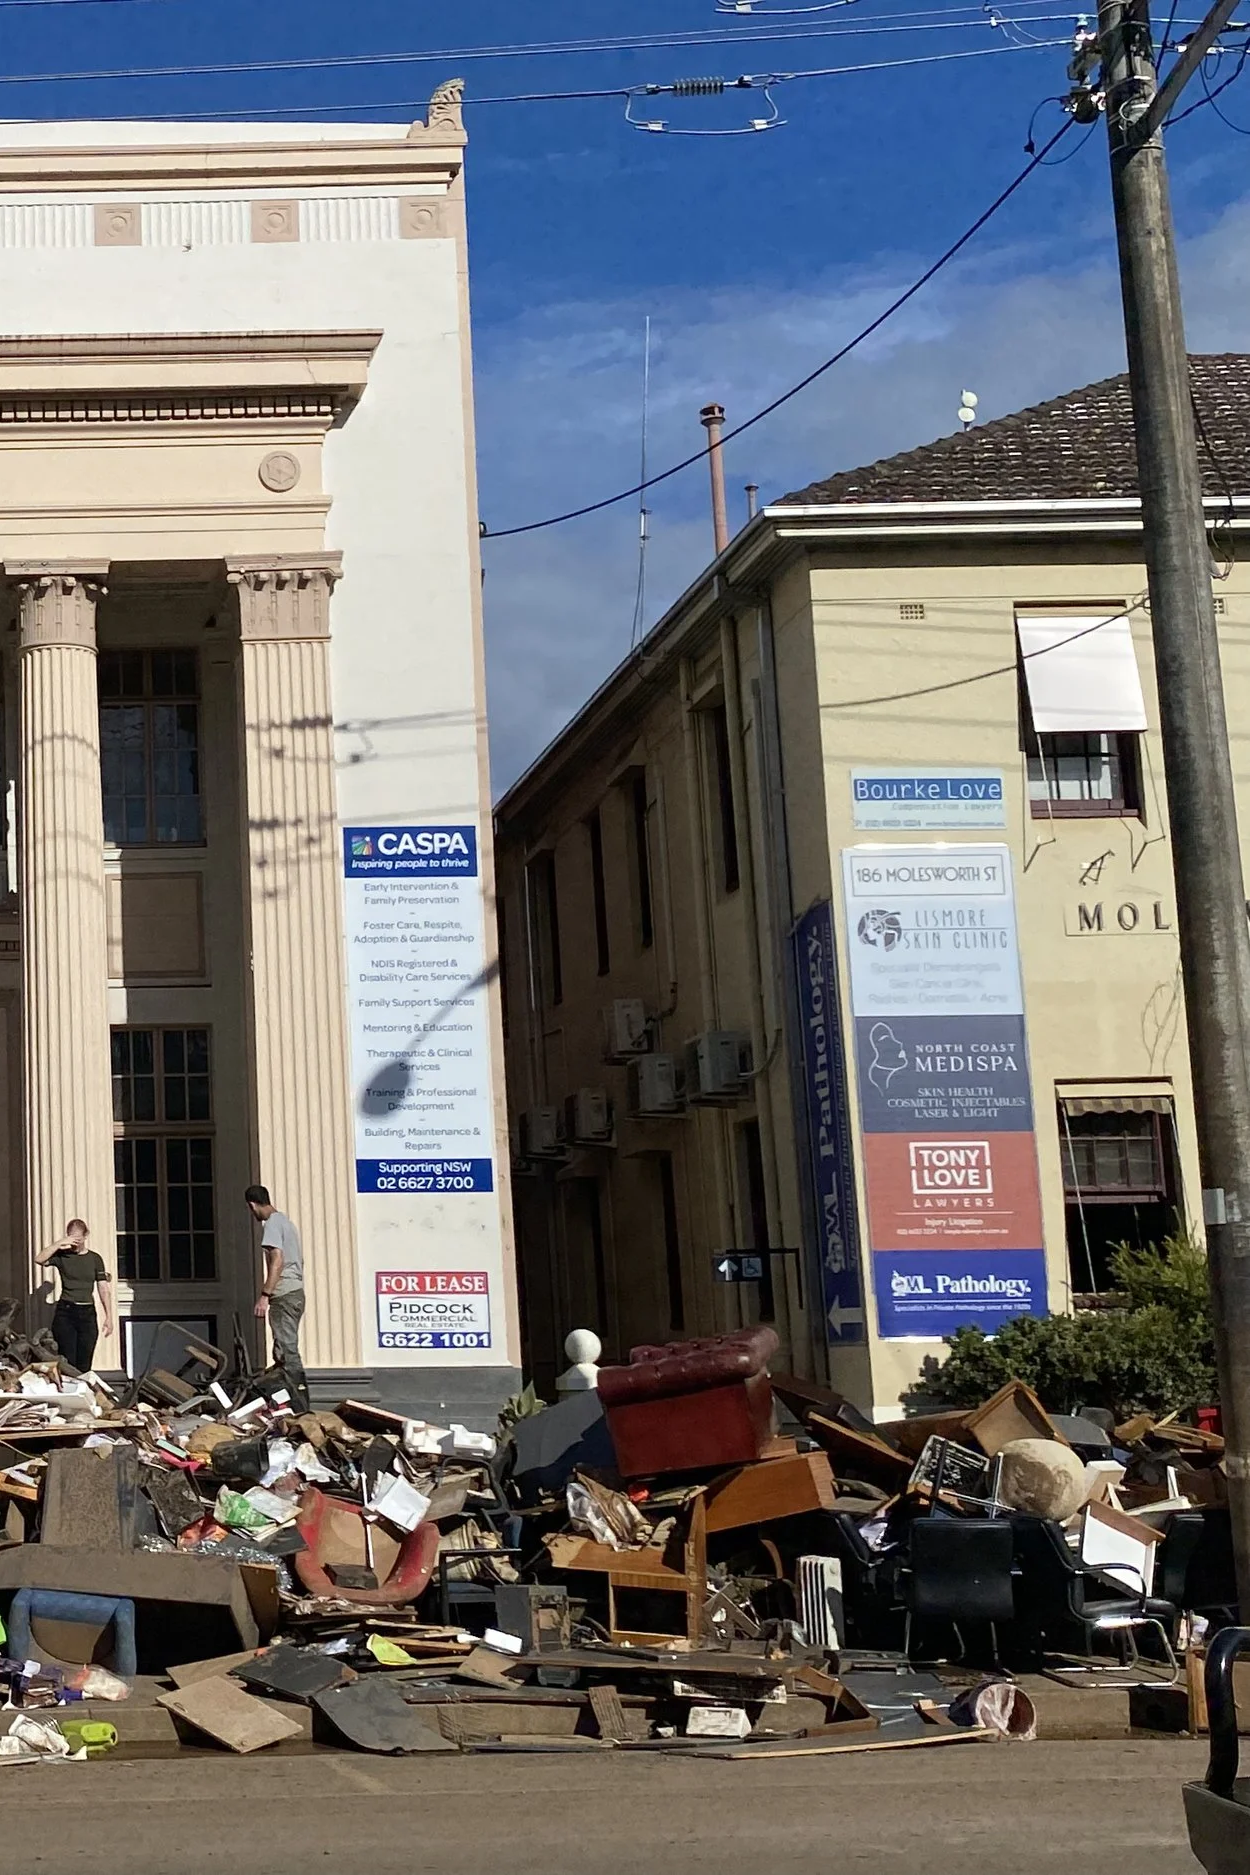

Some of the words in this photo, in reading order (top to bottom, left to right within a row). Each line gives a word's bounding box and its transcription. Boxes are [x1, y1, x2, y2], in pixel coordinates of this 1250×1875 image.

[377, 832, 468, 855] CASPA
[352, 859, 392, 870] Inspiring
[395, 860, 427, 870] people
[429, 860, 440, 868] to
[441, 859, 469, 868] thrive
[856, 869, 882, 883] 186
[886, 867, 980, 882] MOLESWORTH
[984, 866, 997, 881] ST
[364, 883, 388, 893] Early
[390, 883, 449, 891] Intervention
[451, 882, 459, 890] &
[364, 897, 396, 906] Family
[398, 896, 459, 905] Preservation
[915, 909, 986, 927] LISMORE
[1078, 901, 1172, 931] MOL
[363, 921, 394, 930] Foster
[354, 935, 398, 945] Adoption
[400, 935, 408, 943] &
[409, 934, 475, 944] Guardianship
[903, 932, 941, 949] SKIN
[953, 931, 1008, 948] CLINIC
[371, 960, 395, 968] NDIS
[397, 959, 449, 969] Registered
[450, 959, 458, 967] &
[360, 973, 403, 983] Disability
[405, 973, 429, 982] Care
[430, 973, 471, 982] Services
[359, 999, 391, 1008] Family
[392, 999, 432, 1008] Support
[433, 998, 474, 1007] Services
[363, 1023, 412, 1033] Mentoring
[414, 1024, 422, 1032] &
[423, 1023, 472, 1032] Education
[366, 1049, 427, 1059] Therapeutic
[427, 1049, 436, 1057] &
[436, 1048, 472, 1057] Clinical
[915, 1044, 963, 1053] NORTH
[970, 1043, 1017, 1053] COAST
[399, 1062, 441, 1071] Services
[915, 1056, 1018, 1072] MEDISPA
[366, 1088, 405, 1098] Training
[406, 1088, 415, 1097] &
[416, 1087, 476, 1097] Professional
[918, 1088, 944, 1097] SKIN
[948, 1087, 994, 1096] HEALTH
[388, 1102, 455, 1112] Development
[887, 1099, 948, 1108] COSMETIC
[951, 1098, 1026, 1107] INJECTABLES
[914, 1109, 949, 1118] LASER
[952, 1109, 959, 1118] &
[963, 1108, 1000, 1117] LIGHT
[364, 1128, 406, 1138] Building,
[408, 1127, 471, 1136] Maintenance
[472, 1127, 481, 1136] &
[405, 1142, 442, 1151] Repairs
[919, 1150, 980, 1166] TONY
[379, 1162, 443, 1175] Supporting
[443, 1161, 471, 1173] NSW
[377, 1178, 396, 1189] 02
[398, 1177, 435, 1189] 6627
[436, 1177, 474, 1189] 3700
[923, 1169, 981, 1186] LOVE
[913, 1198, 995, 1208] LAWYERS
[380, 1276, 420, 1292] FOR
[424, 1276, 485, 1292] LEASE
[935, 1274, 1031, 1297] Pathology.
[389, 1302, 474, 1314] PIDCOCK
[390, 1314, 477, 1322] COMMERCIAL
[381, 1333, 433, 1347] 6622
[440, 1333, 489, 1347] 1001
